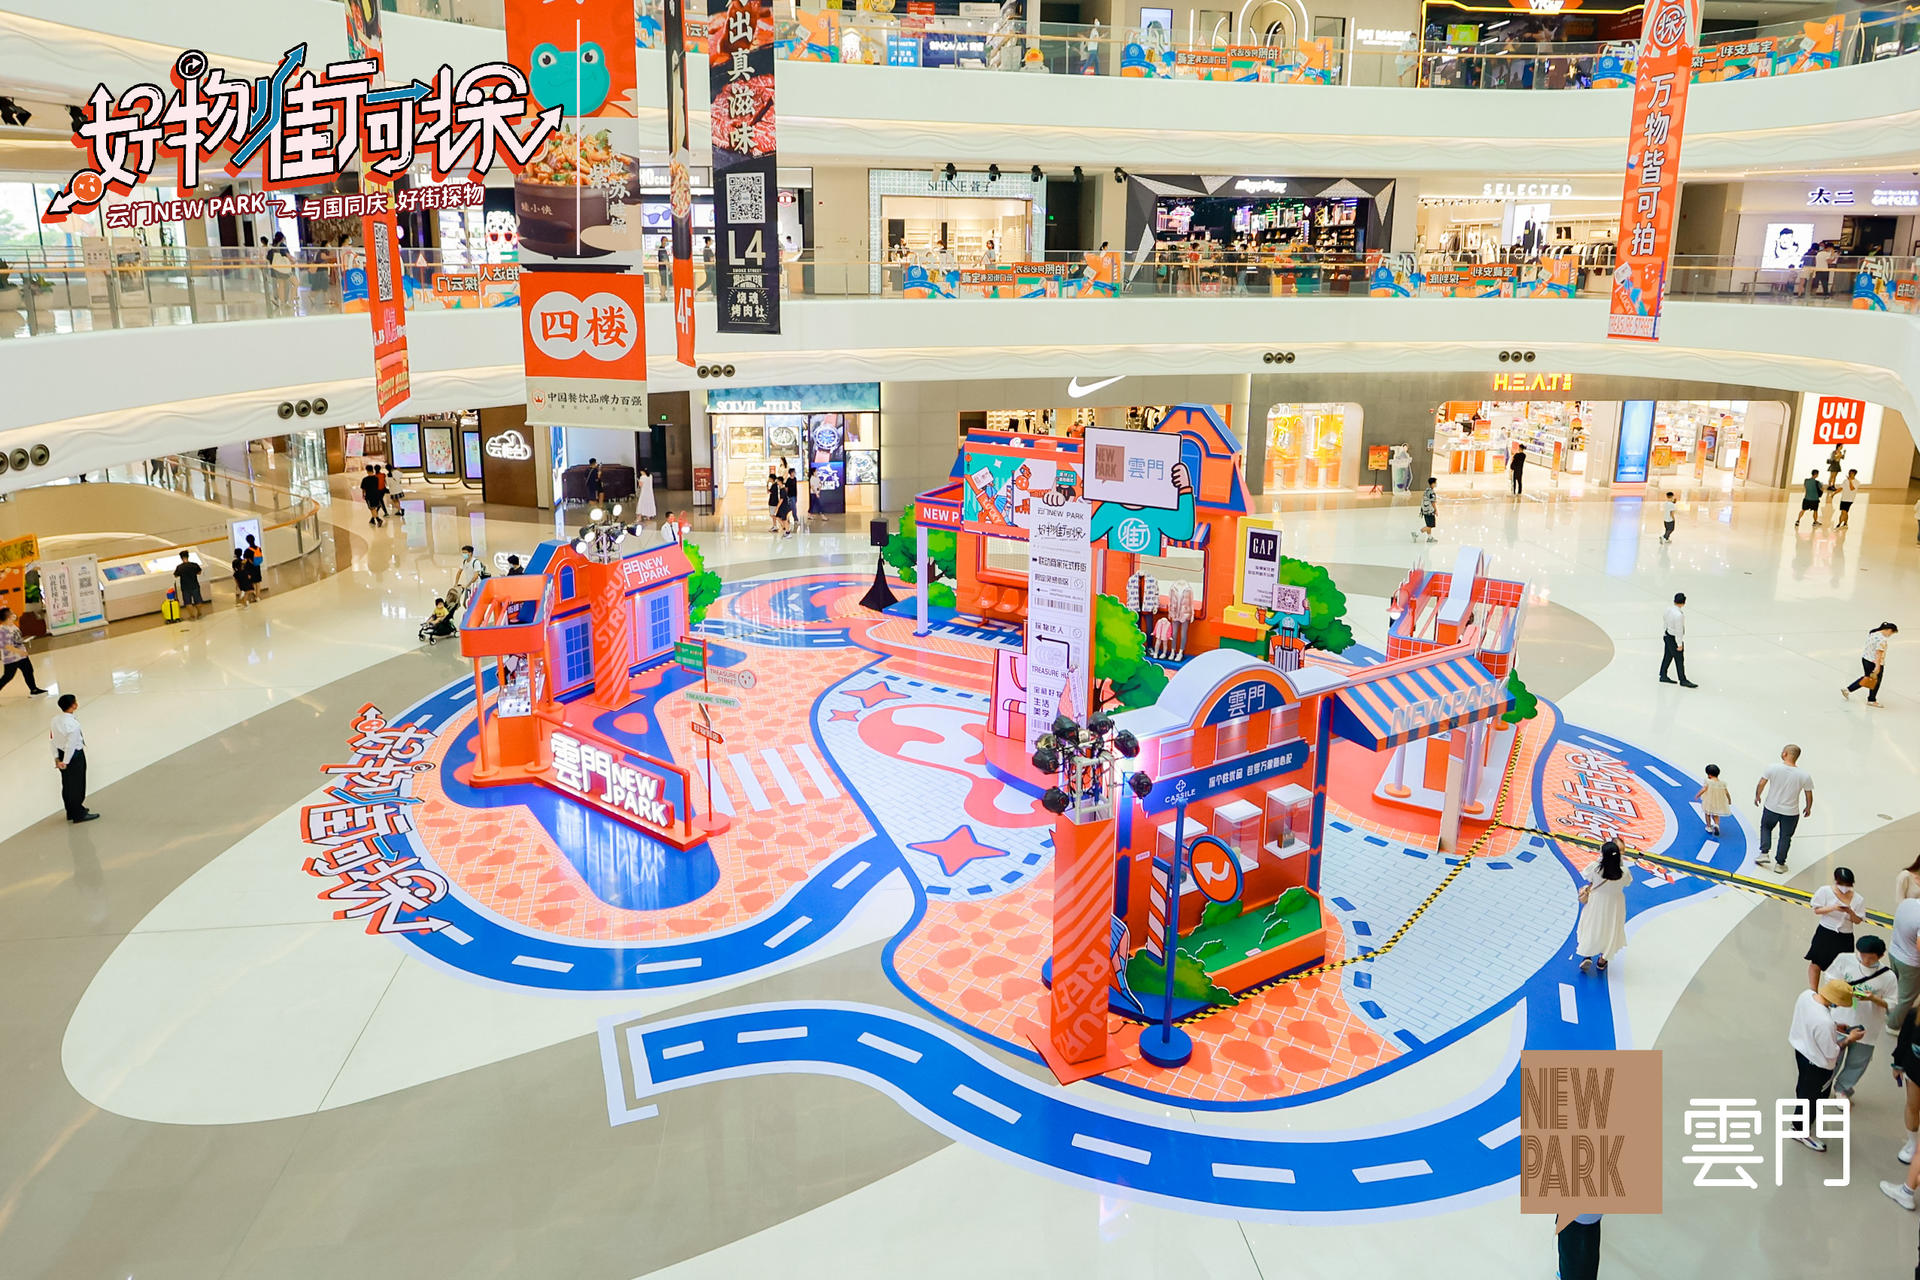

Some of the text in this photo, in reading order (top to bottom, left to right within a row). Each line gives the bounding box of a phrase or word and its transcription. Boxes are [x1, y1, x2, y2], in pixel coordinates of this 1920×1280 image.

[726, 0, 756, 155] 出真滋味
[1630, 73, 1675, 256] 万物皆可拍
[1483, 183, 1572, 198] SELECTED
[1808, 187, 1855, 205] 太二
[728, 230, 766, 266] L4
[540, 305, 629, 348] 四楼
[1821, 402, 1858, 420] UNI
[1818, 421, 1858, 441] QLO
[1128, 457, 1164, 481] 雲門
[923, 507, 950, 522] NEW
[1066, 511, 1084, 520] PARK
[1252, 537, 1274, 556] GAP
[640, 556, 664, 572] NEW
[643, 565, 671, 583] PARK
[1032, 665, 1059, 678] TREASURE
[1228, 684, 1266, 717] 雲門
[1391, 676, 1510, 735] NEW PARK
[551, 732, 615, 803] 雲門
[612, 762, 658, 800] NEW
[613, 785, 668, 828] PARK
